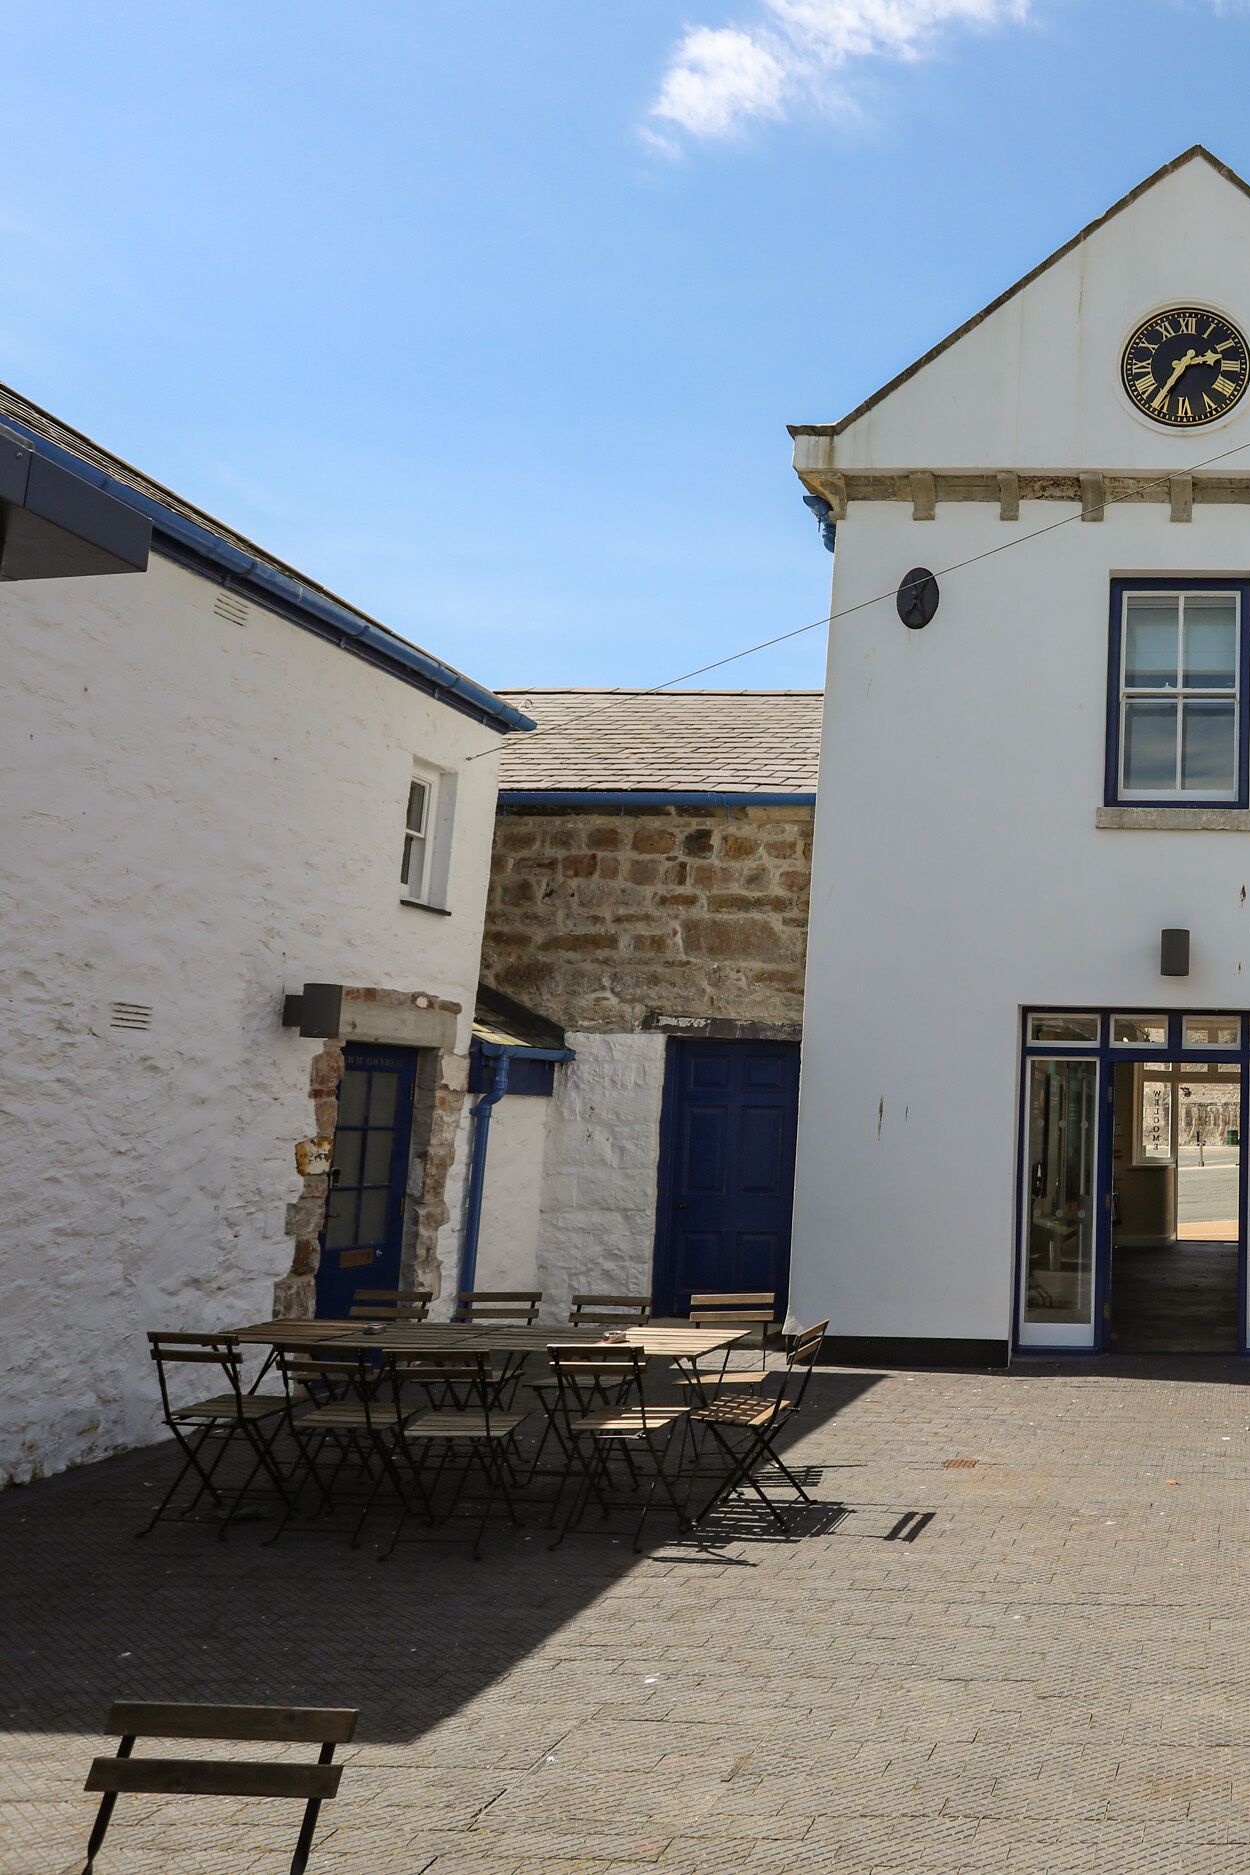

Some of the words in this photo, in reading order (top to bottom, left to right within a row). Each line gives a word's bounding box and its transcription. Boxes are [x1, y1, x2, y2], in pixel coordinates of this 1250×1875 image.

[1154, 321, 1178, 342] XI
[1177, 317, 1197, 335] XII
[1201, 323, 1217, 339] I
[1138, 338, 1160, 354] X
[1214, 338, 1236, 354] II
[1132, 358, 1152, 374] IX
[1221, 360, 1241, 372] III
[1134, 374, 1158, 400] VIII
[1211, 374, 1237, 398] IIII
[1176, 396, 1194, 416] VI
[1201, 391, 1218, 412] V
